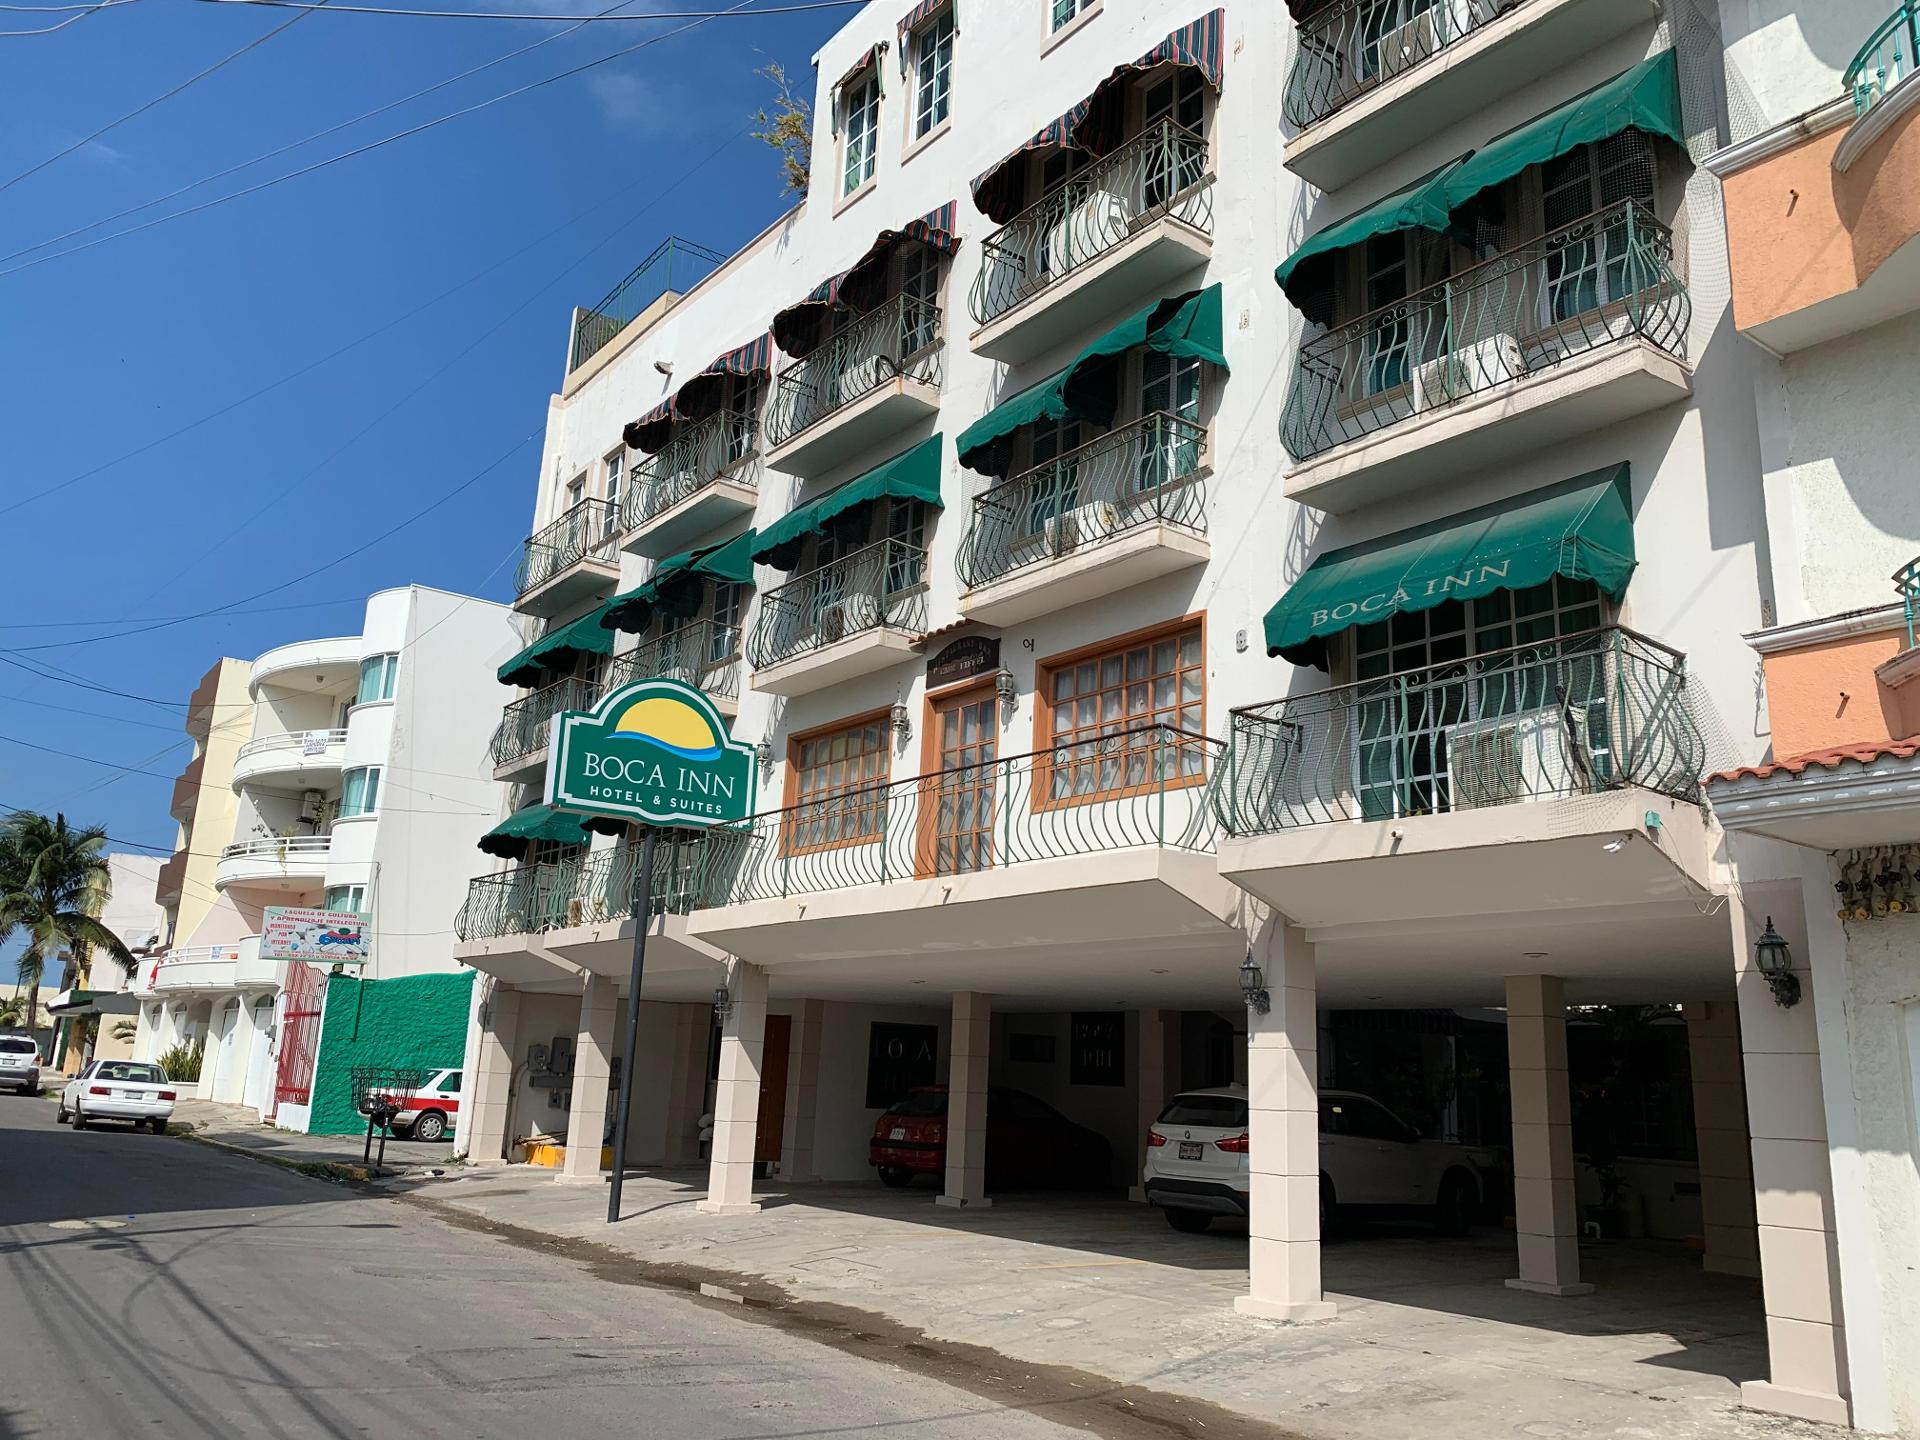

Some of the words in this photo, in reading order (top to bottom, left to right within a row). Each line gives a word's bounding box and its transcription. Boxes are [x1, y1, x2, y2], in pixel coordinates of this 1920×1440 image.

[1311, 587, 1411, 628] BOCA
[1423, 559, 1511, 597] INN
[583, 752, 665, 788] BOCA
[676, 768, 735, 799] INN
[589, 785, 643, 803] HOTEL
[653, 795, 661, 806] &
[670, 797, 723, 815] SUITES
[326, 919, 368, 927] INTELECTUAL
